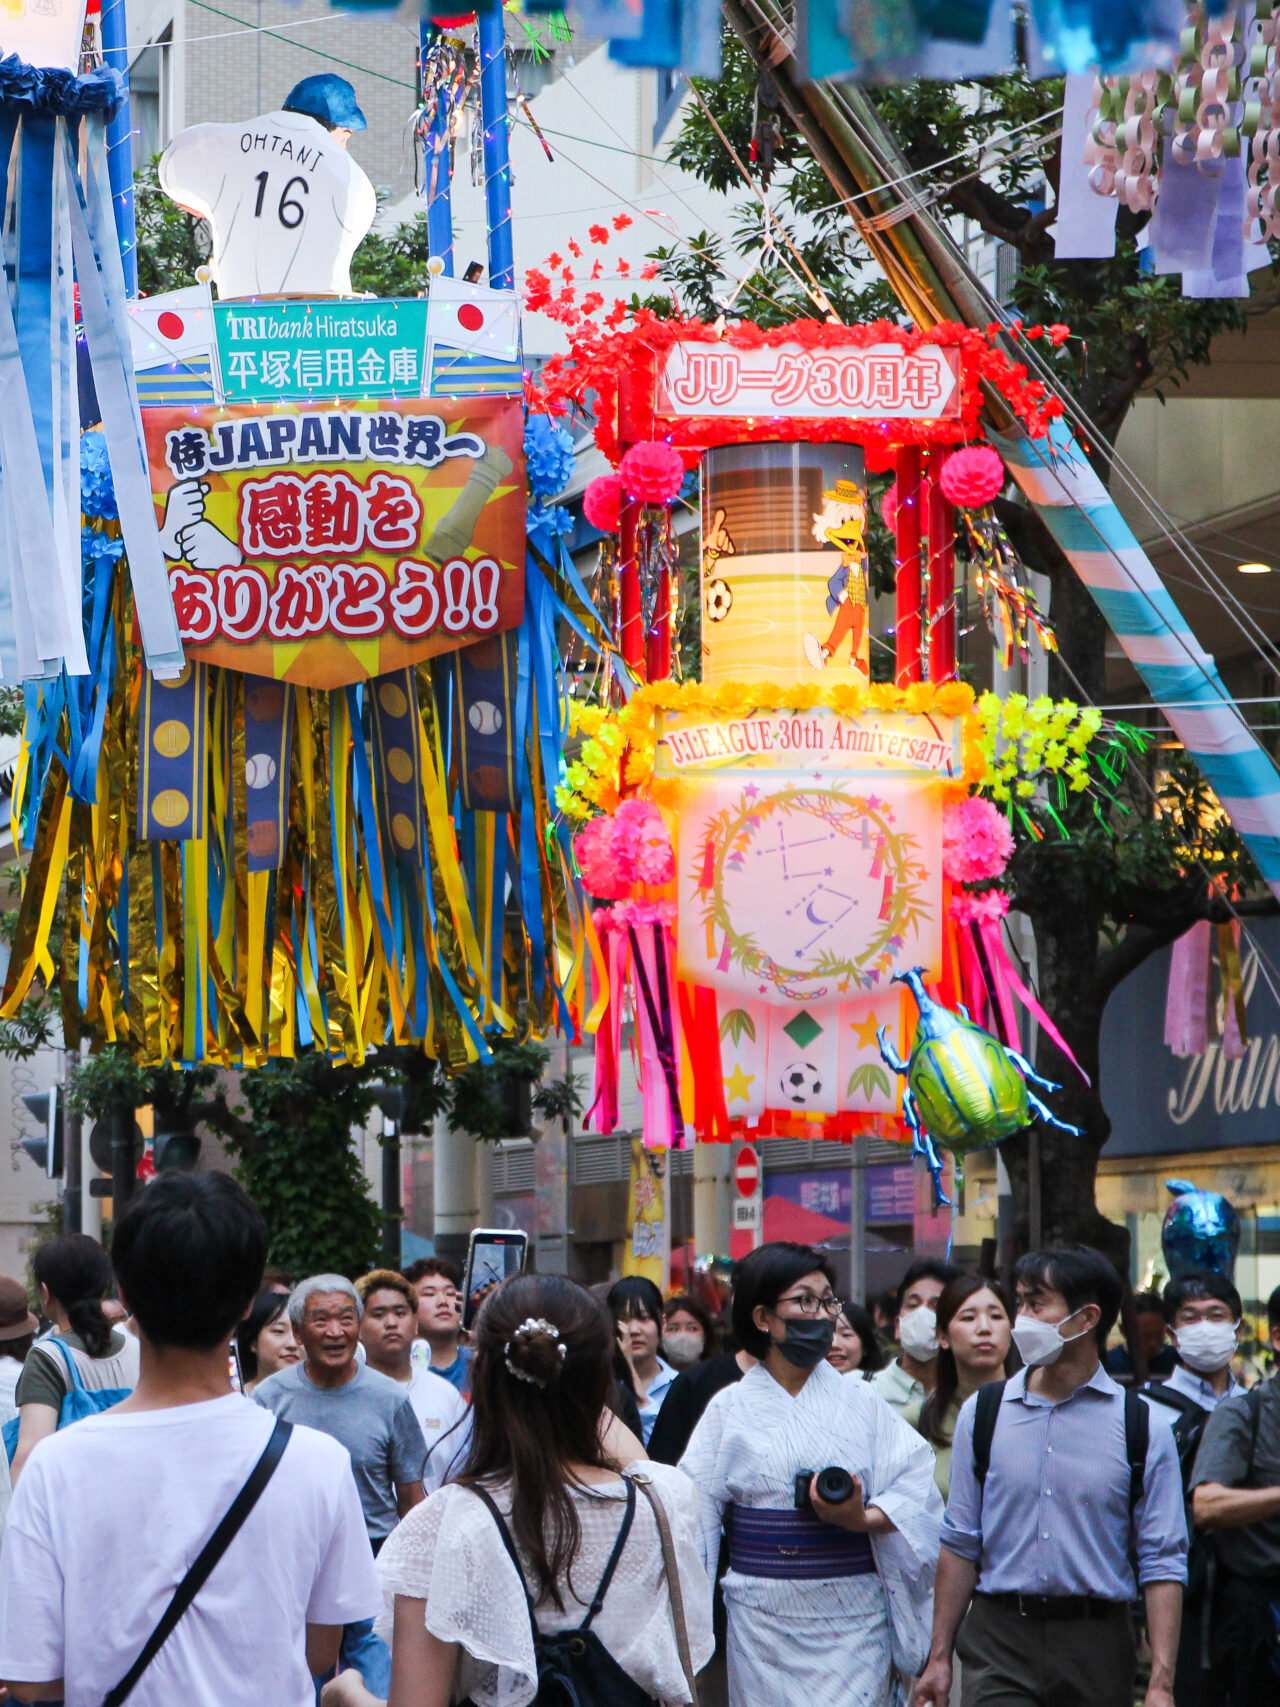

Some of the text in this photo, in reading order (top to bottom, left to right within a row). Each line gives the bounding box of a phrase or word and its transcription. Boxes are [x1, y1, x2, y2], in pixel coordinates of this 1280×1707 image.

[239, 132, 325, 174] OHTANI
[253, 170, 310, 229] 16
[226, 314, 398, 340] TRIbank Hiratsuka
[227, 346, 419, 390] 平塚信用金庫
[675, 354, 940, 409] Jリーグ30周年
[168, 413, 483, 478] 侍JAPAN世界一
[243, 477, 419, 553] 感動を
[780, 719, 824, 750] 30th
[830, 718, 952, 770] Anniversary
